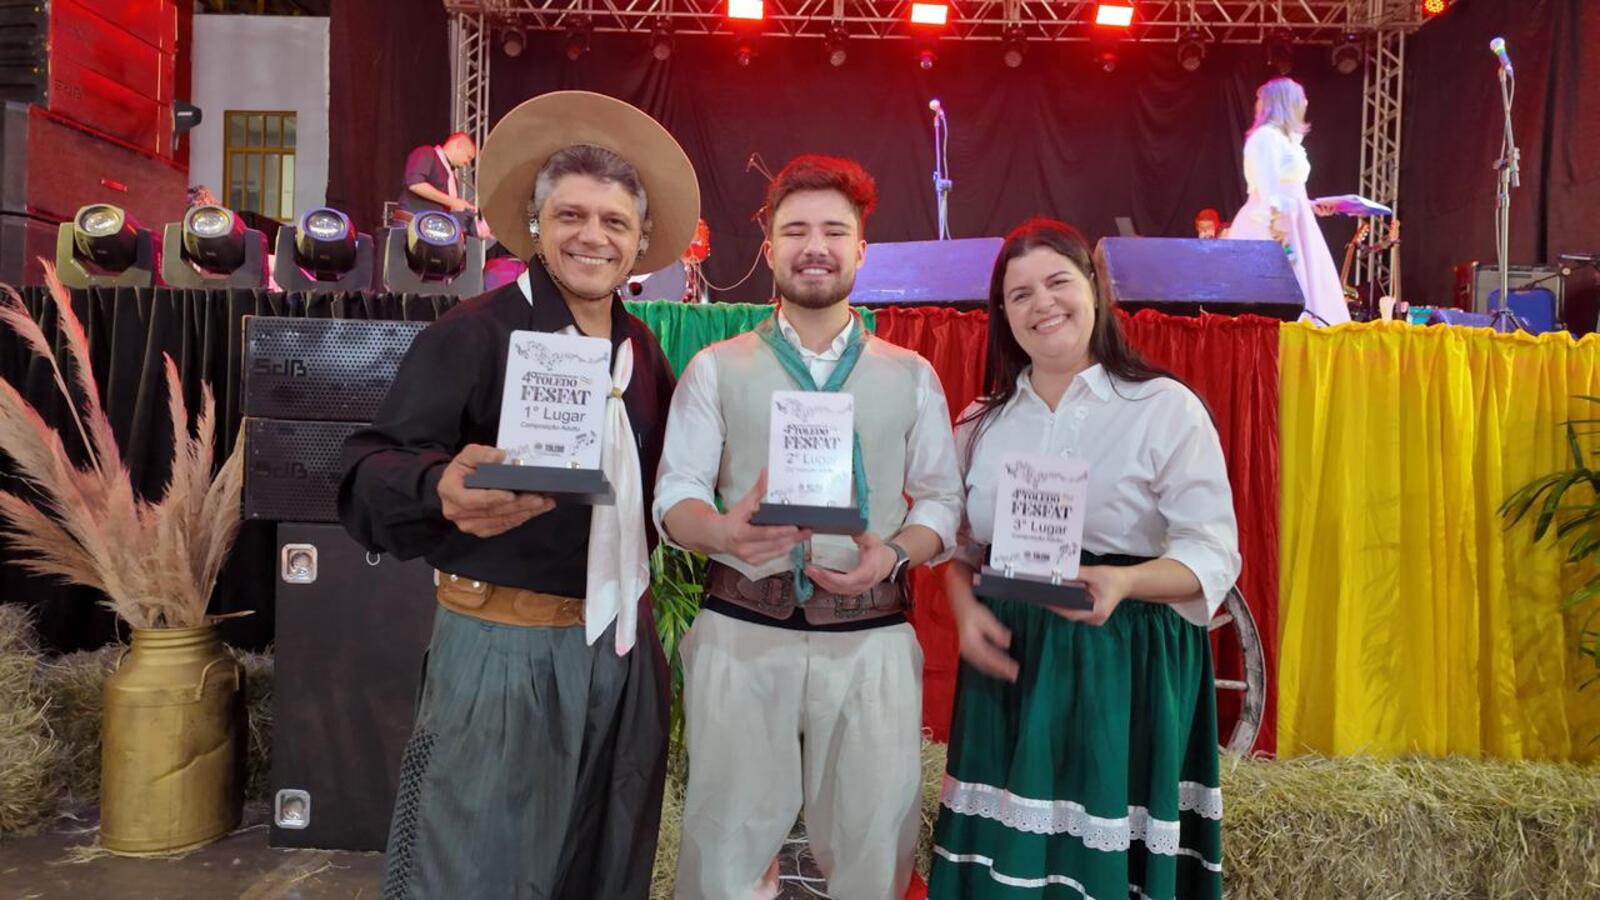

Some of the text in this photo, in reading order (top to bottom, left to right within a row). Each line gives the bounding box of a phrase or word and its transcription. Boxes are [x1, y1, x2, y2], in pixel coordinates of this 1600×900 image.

[536, 376, 578, 387] TOLEDO
[521, 385, 591, 405] FESFAT
[543, 407, 586, 424] Lugar
[783, 435, 841, 450] FESFAT
[1012, 501, 1073, 519] FESFAT
[1030, 520, 1067, 535] Lugar
